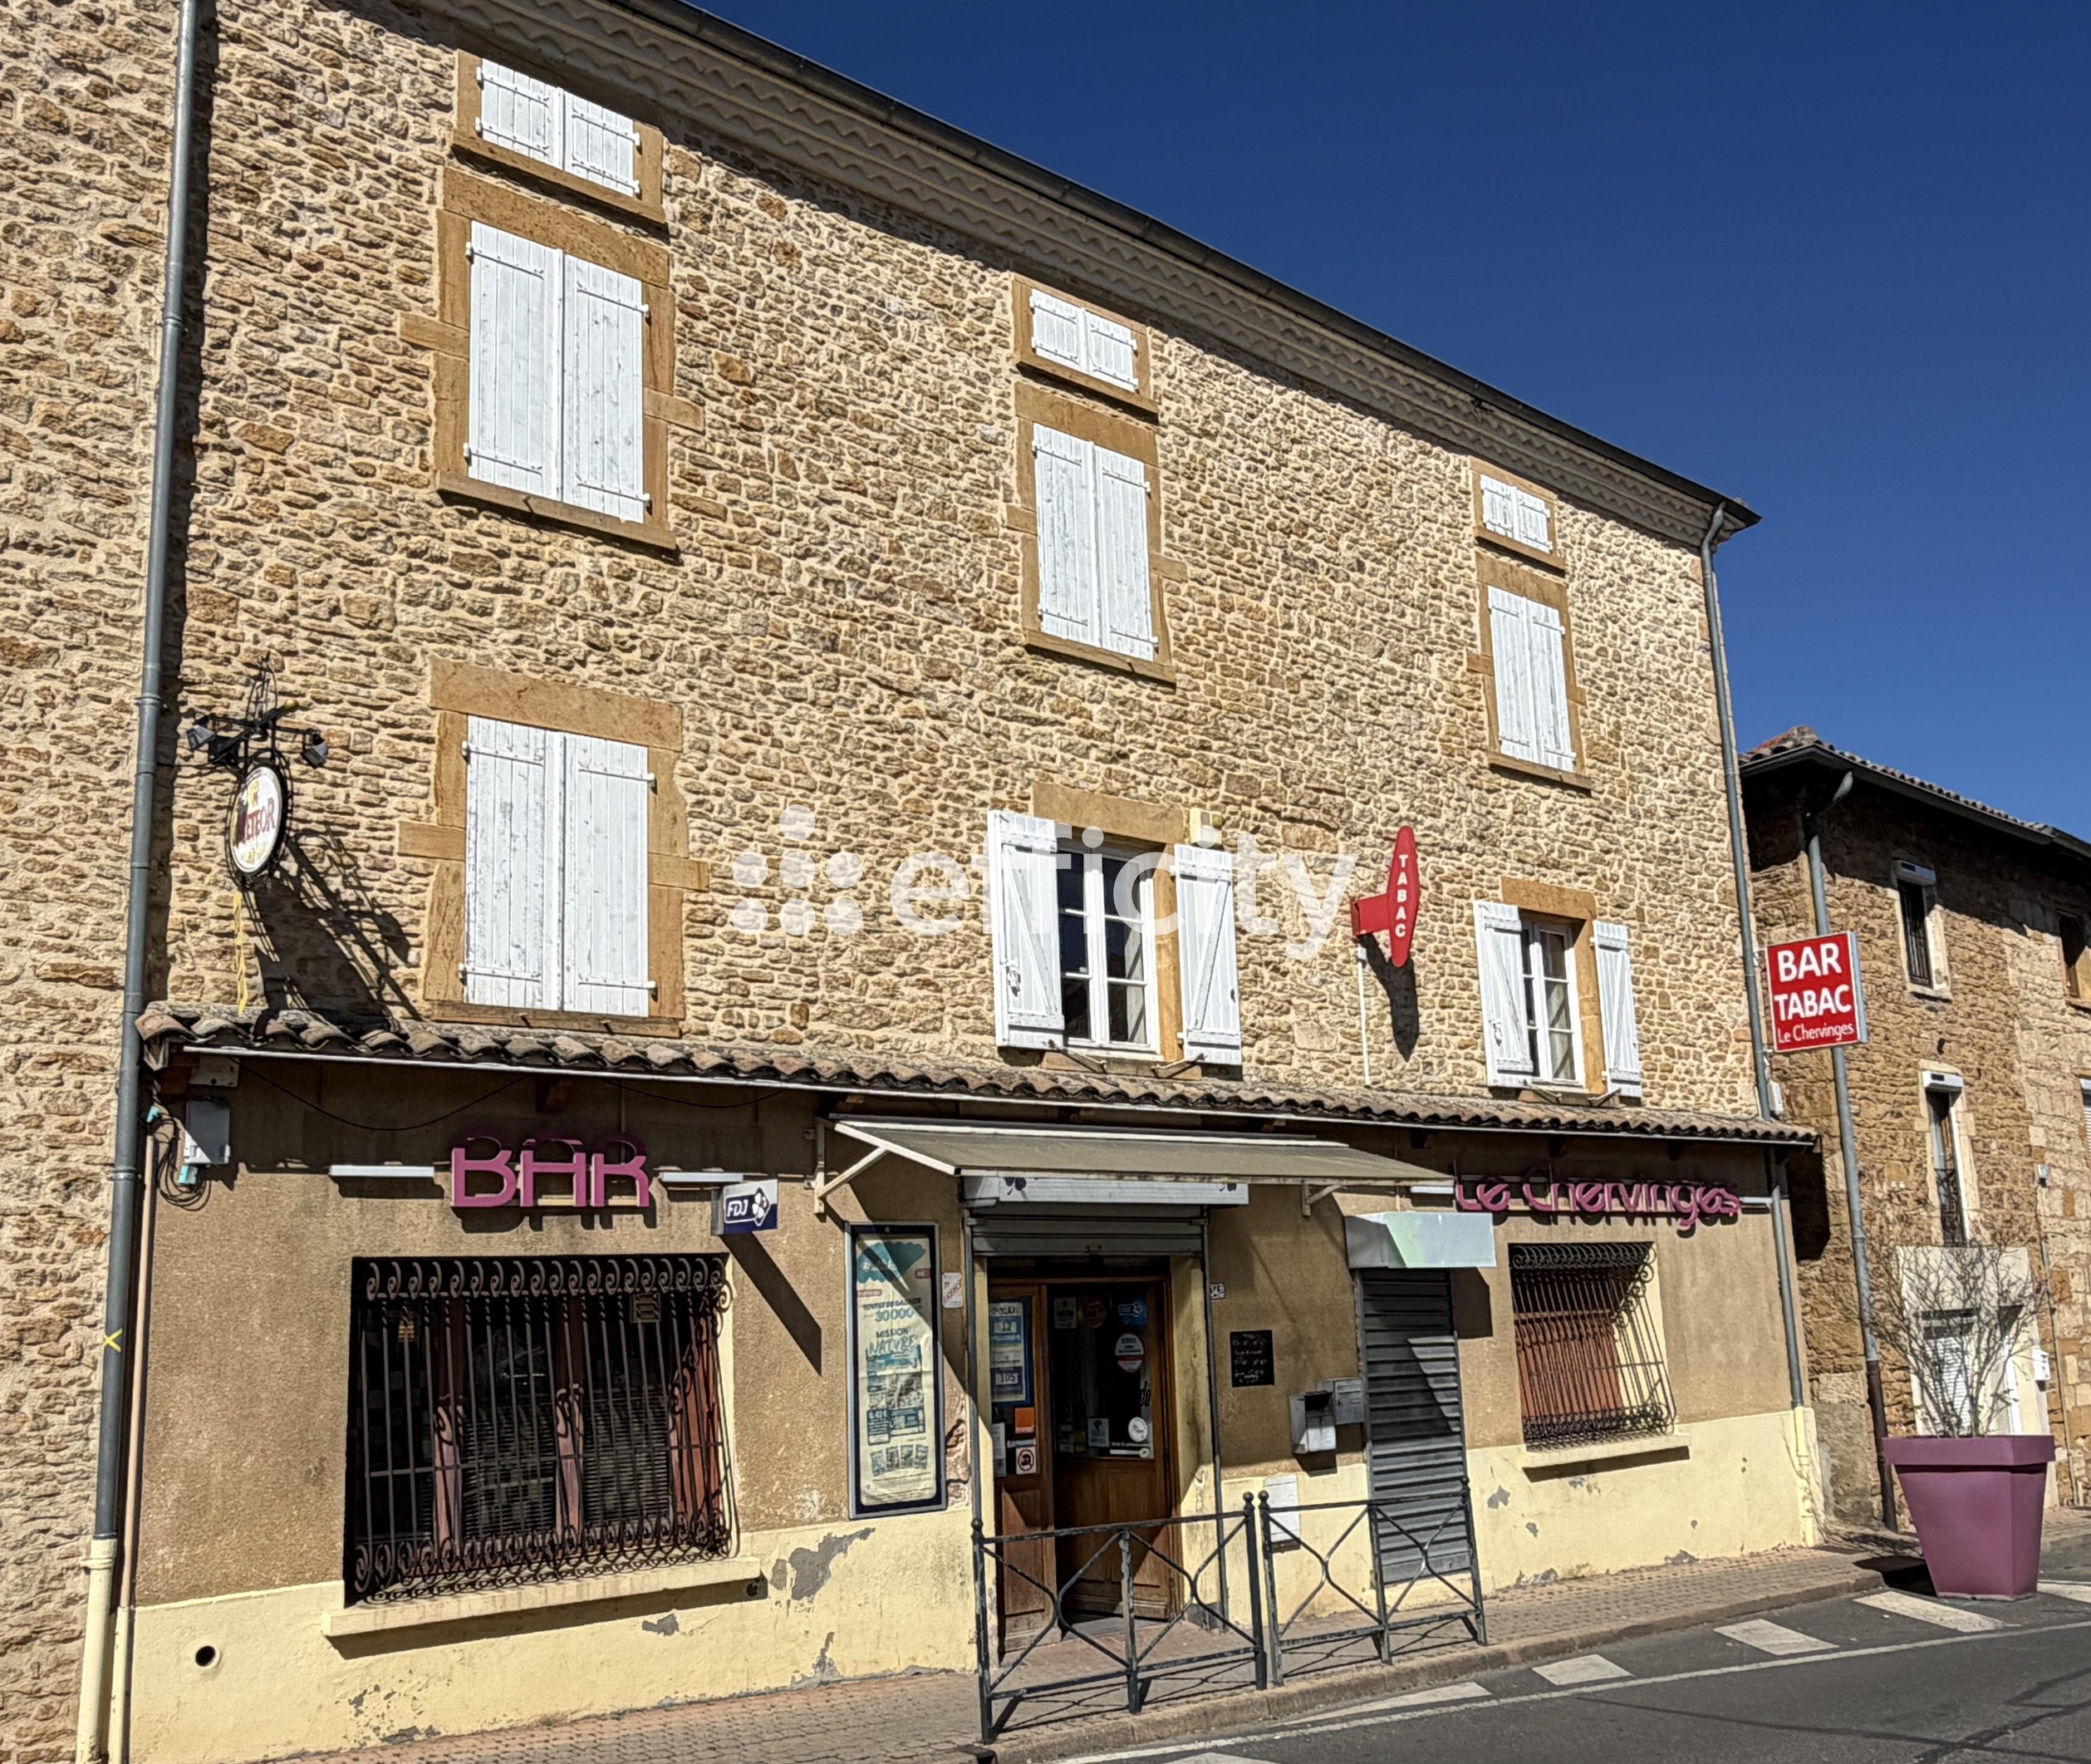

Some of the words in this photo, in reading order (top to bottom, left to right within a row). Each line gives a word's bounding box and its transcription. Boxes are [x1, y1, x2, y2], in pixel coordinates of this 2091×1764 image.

[1395, 854, 1409, 937] TABAC
[1777, 942, 1843, 982] BAR
[1774, 984, 1852, 1021] TABAC
[1778, 1028, 1791, 1044] Le
[1793, 1022, 1854, 1041] Chervinges
[451, 1130, 650, 1207] BAR
[725, 1198, 749, 1217] FDJ
[1455, 1177, 1510, 1211] Le
